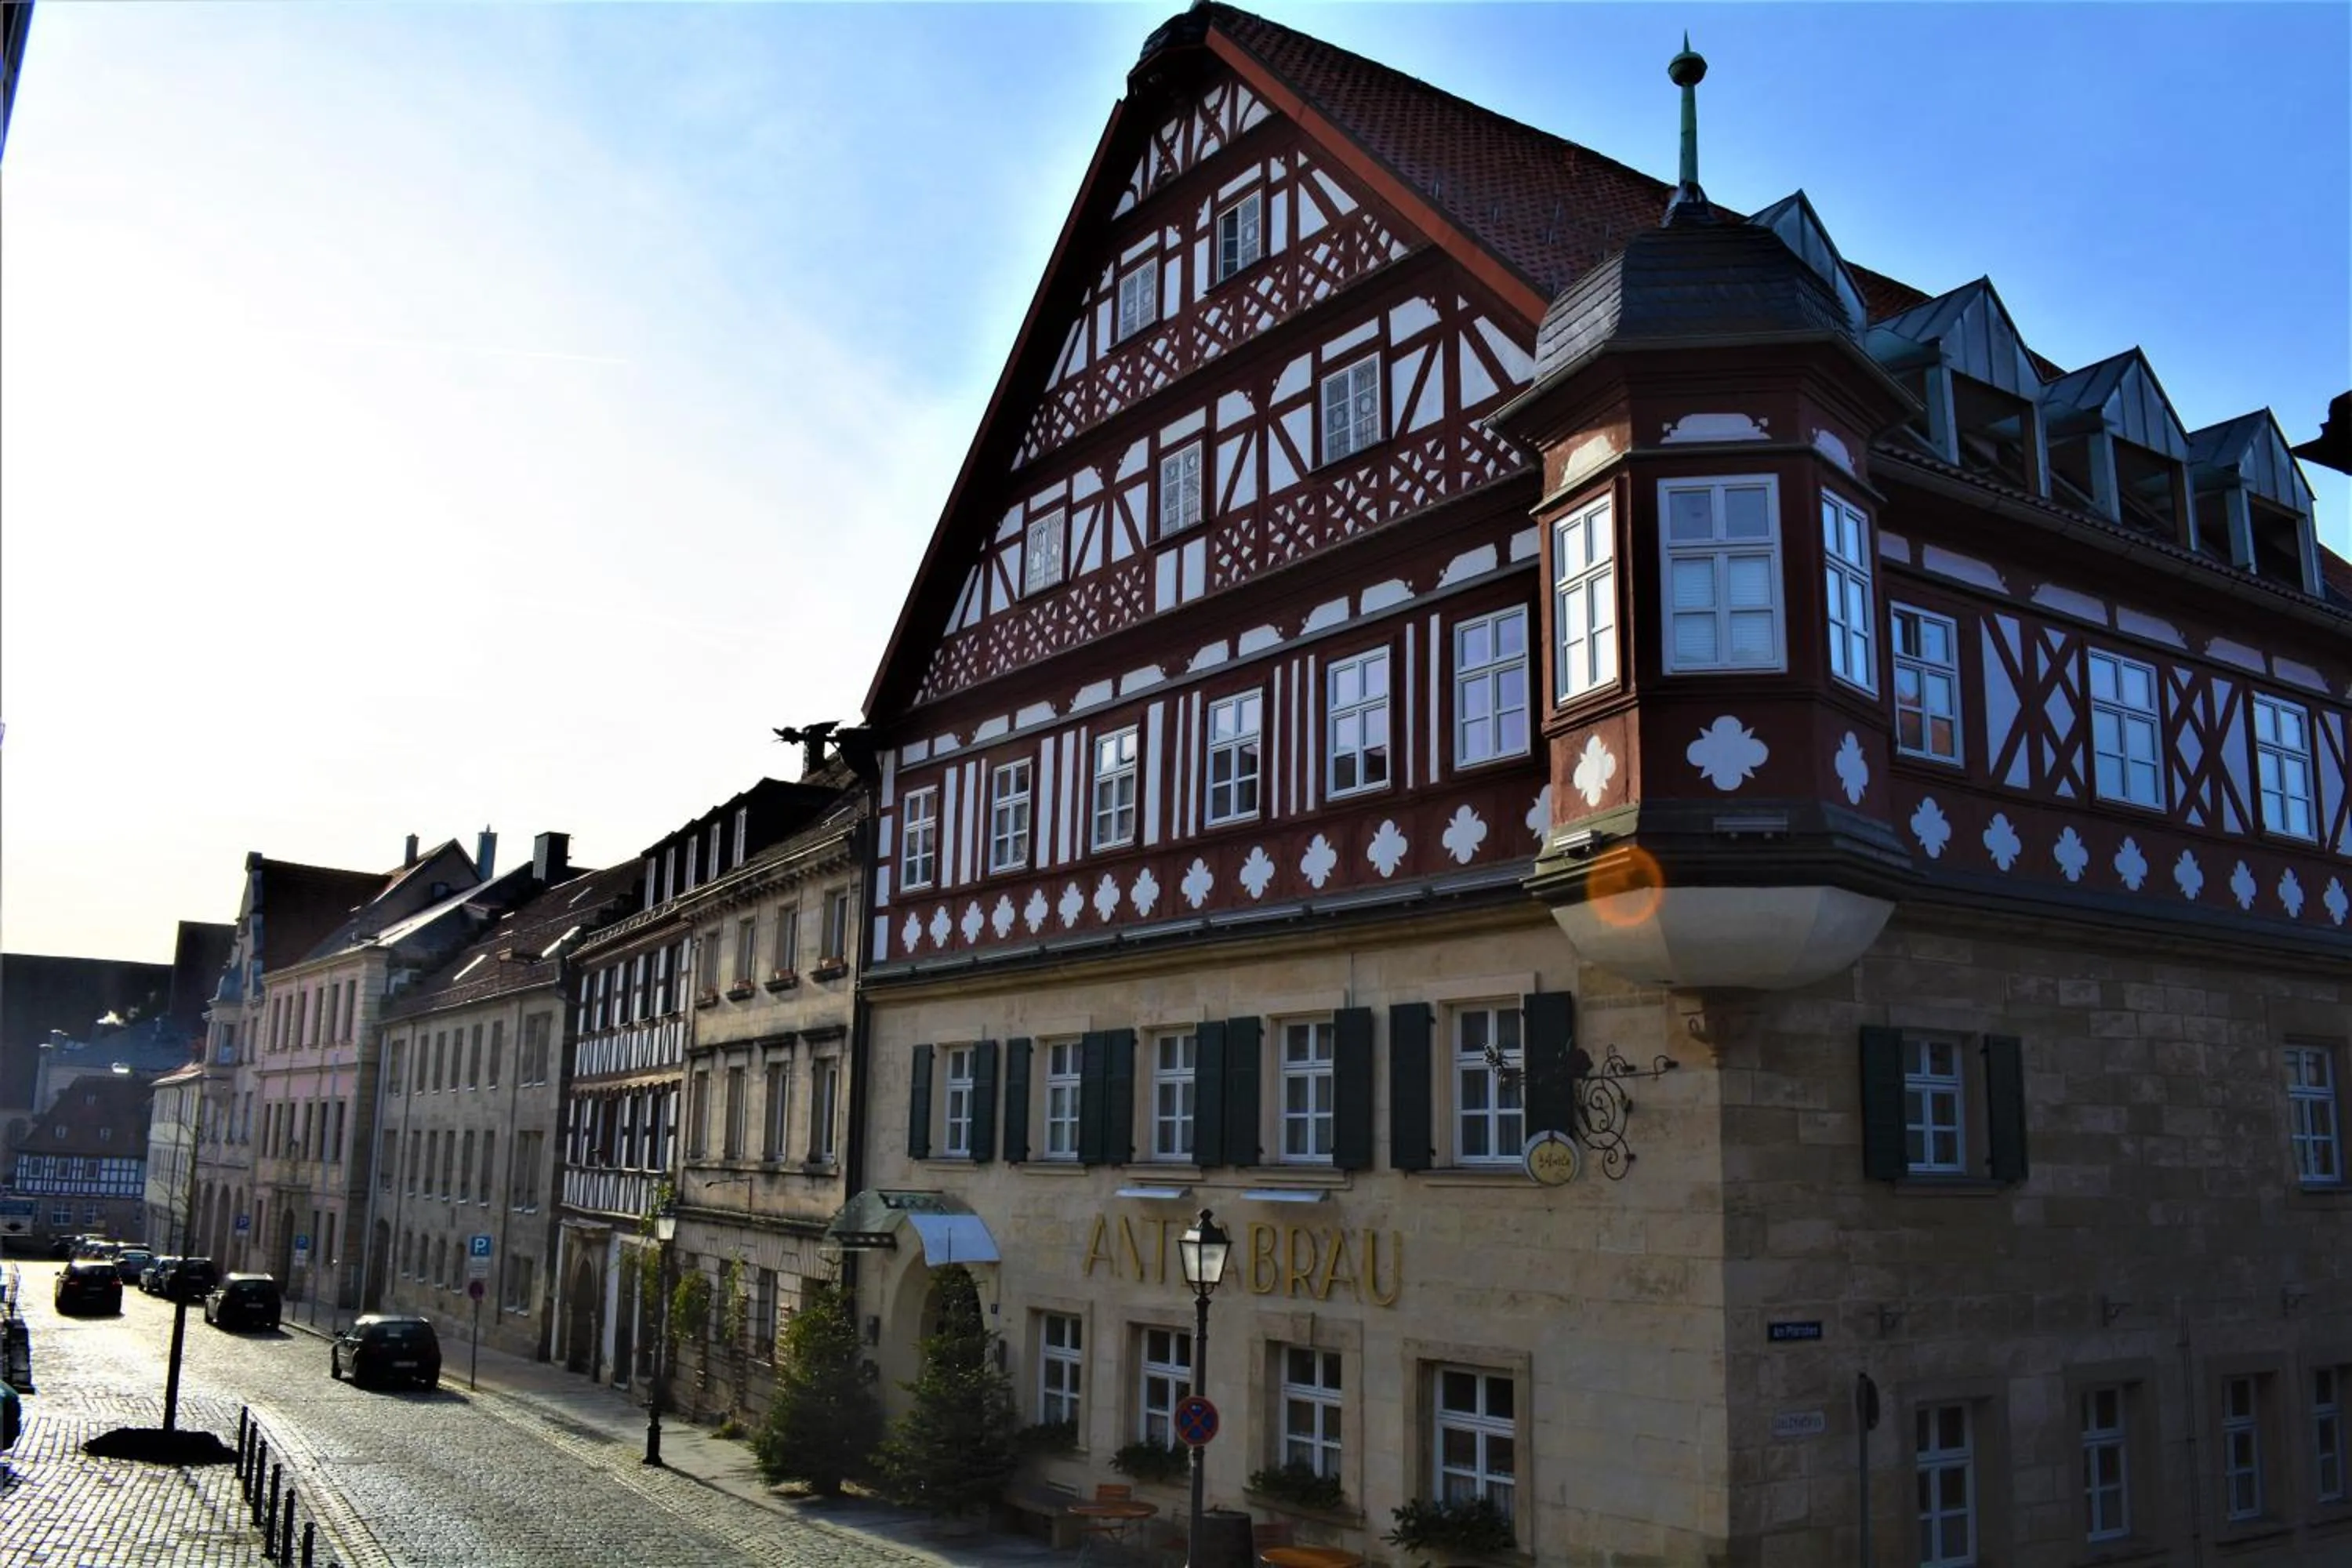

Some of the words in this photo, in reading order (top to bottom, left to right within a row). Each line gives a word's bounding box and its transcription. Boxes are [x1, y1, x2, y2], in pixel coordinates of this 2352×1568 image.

[474, 1237, 487, 1254] P
[1083, 1213, 1242, 1293] ANTA
[1247, 1221, 1403, 1307] BRÄU
